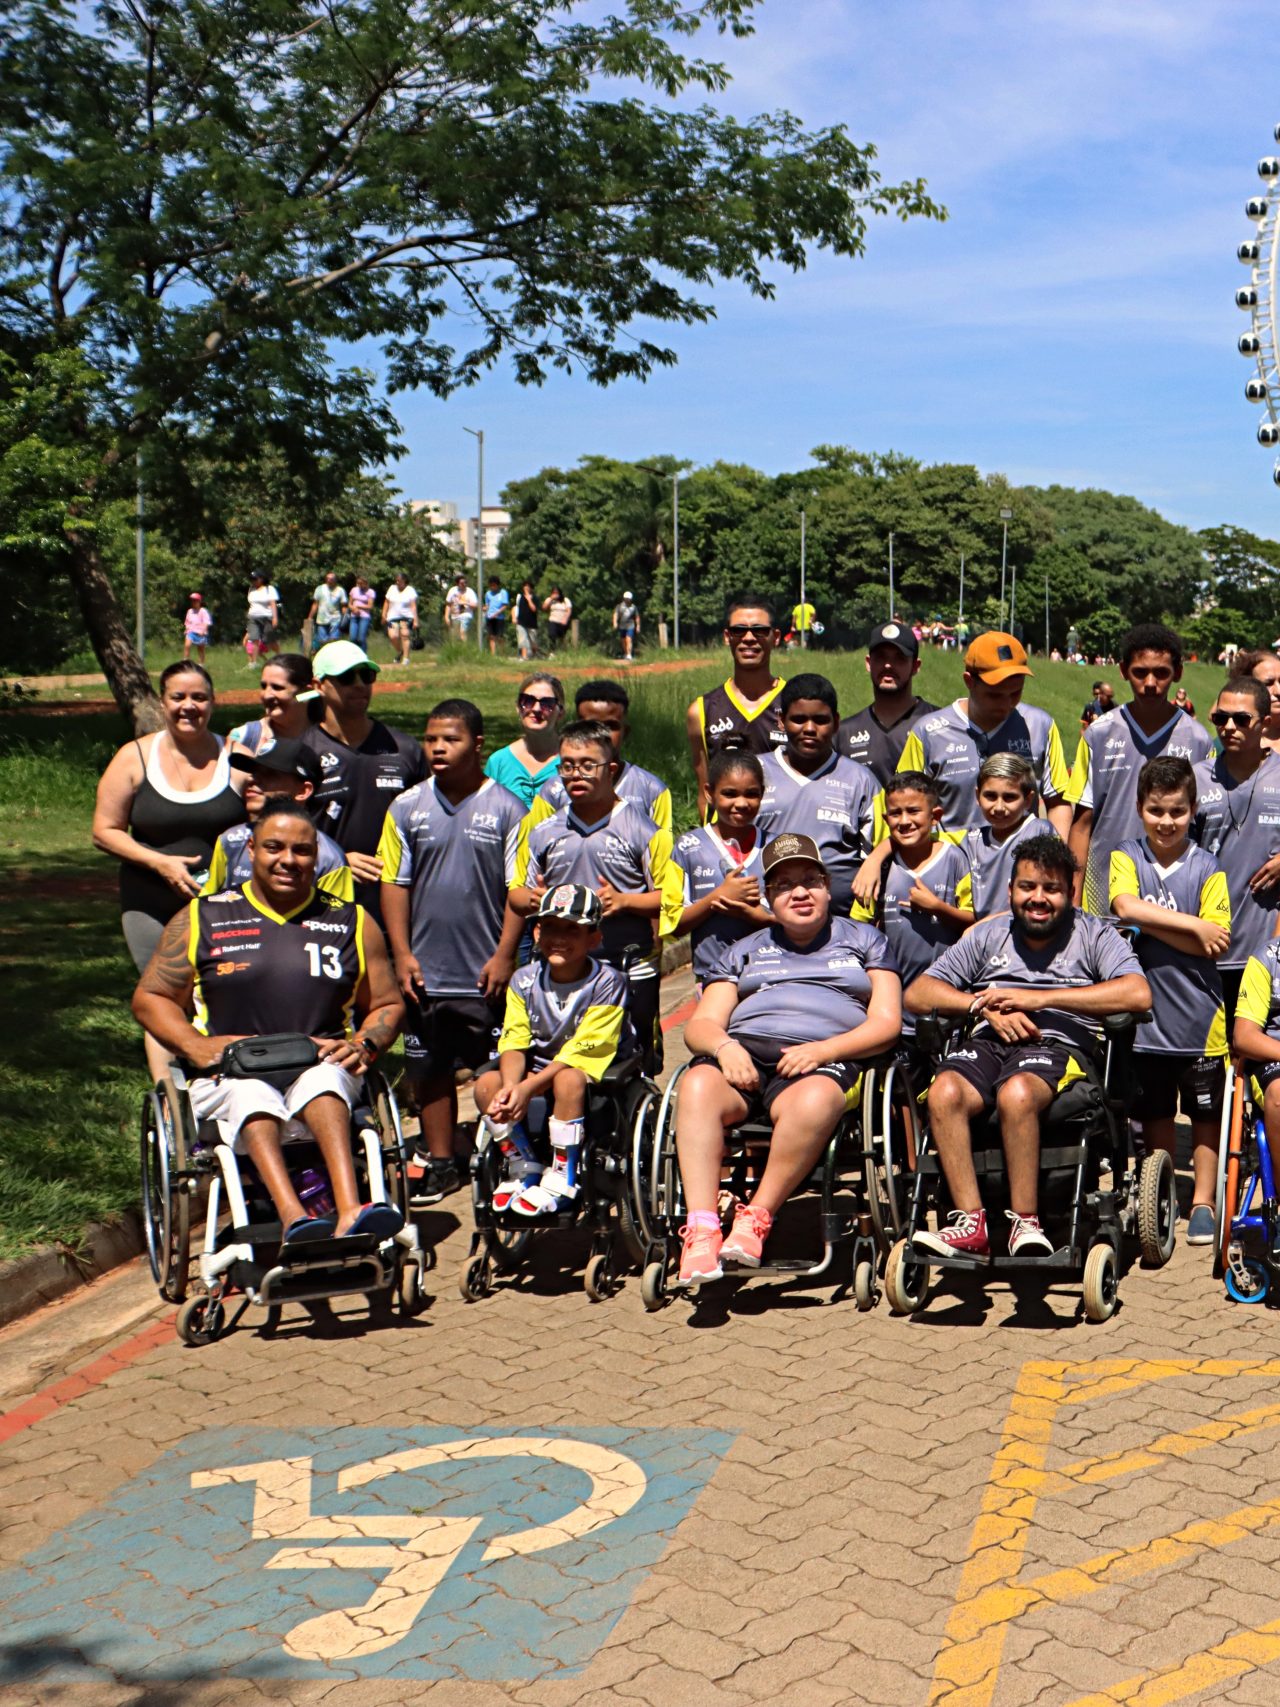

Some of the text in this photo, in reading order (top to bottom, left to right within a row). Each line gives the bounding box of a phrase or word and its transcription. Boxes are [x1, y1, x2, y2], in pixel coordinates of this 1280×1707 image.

[709, 716, 734, 734] add
[849, 730, 870, 744] add
[1200, 788, 1223, 804] add
[222, 942, 261, 953] Robert Half
[304, 942, 342, 980] 13
